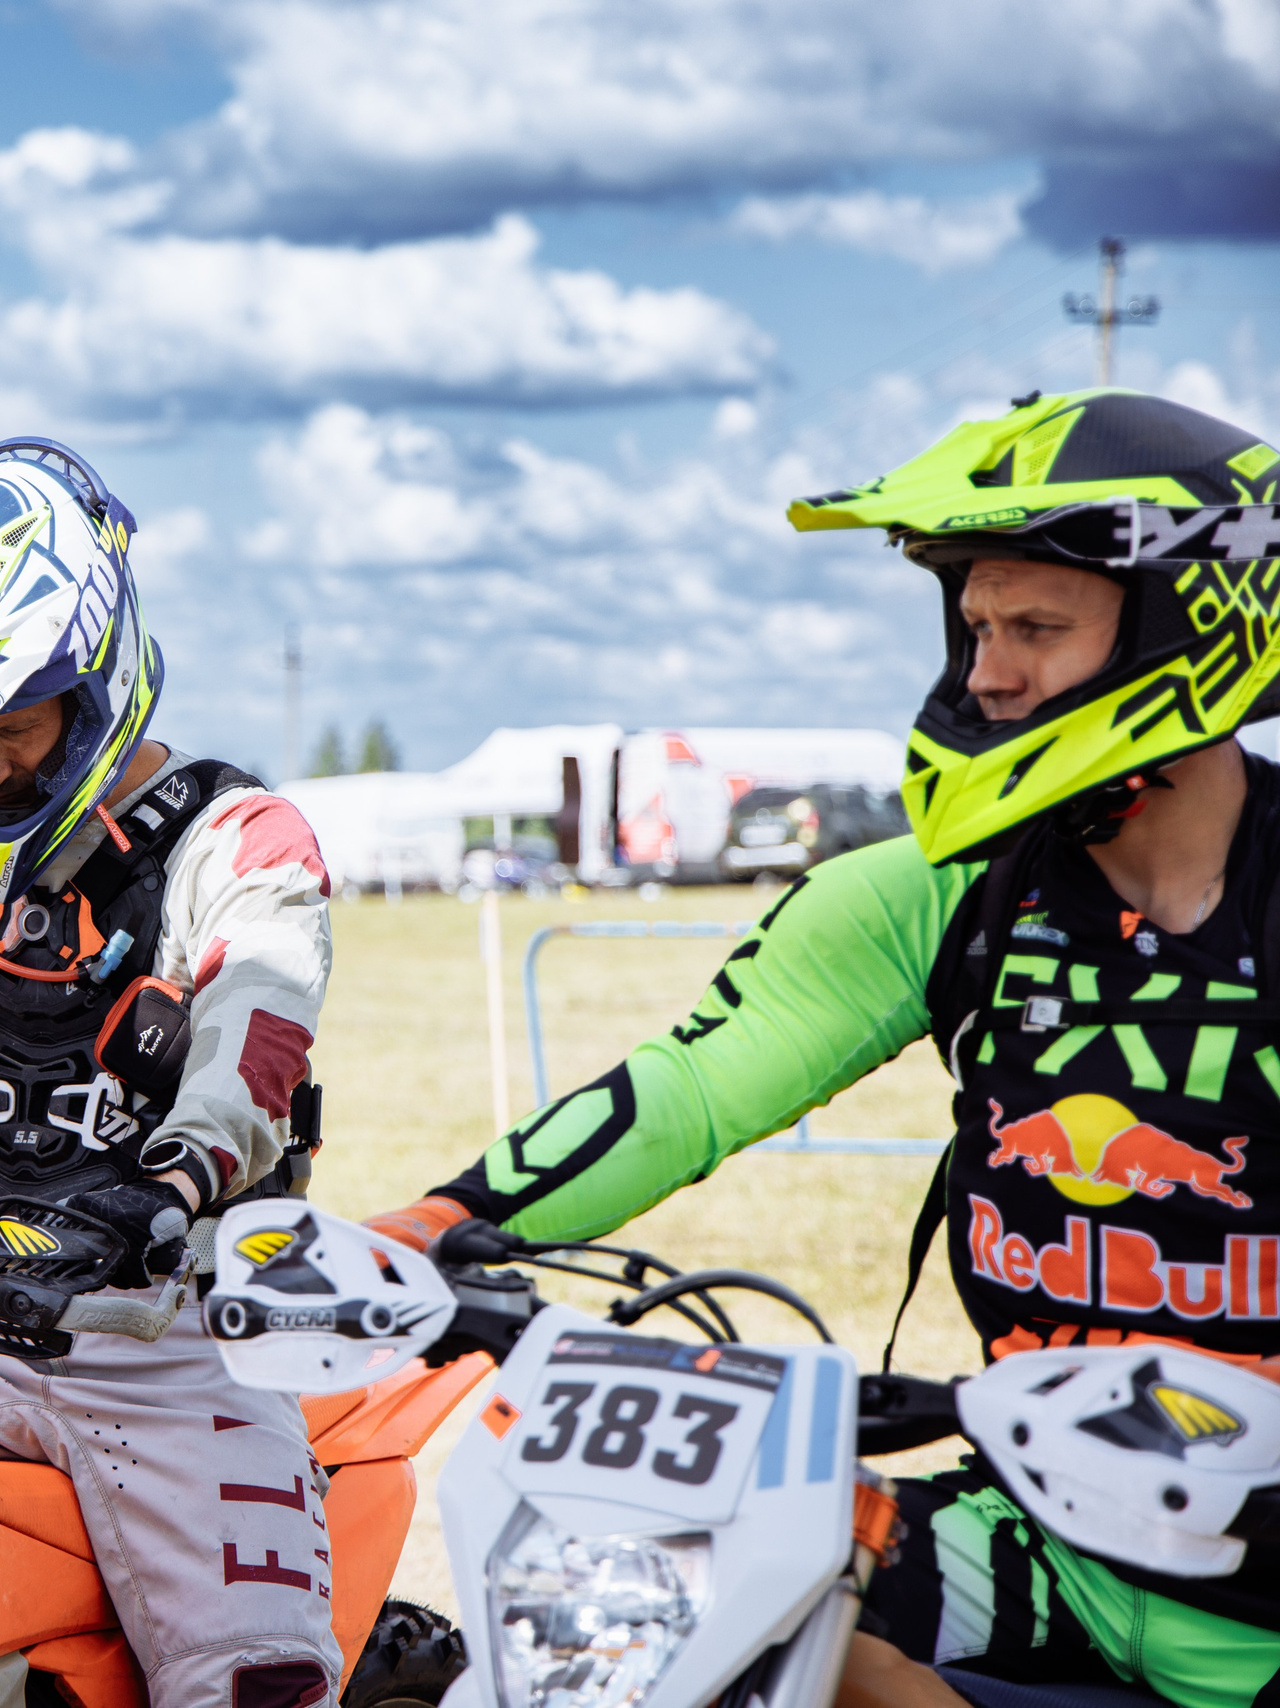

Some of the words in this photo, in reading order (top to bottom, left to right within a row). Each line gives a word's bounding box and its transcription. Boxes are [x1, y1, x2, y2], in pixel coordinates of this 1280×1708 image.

[154, 789, 183, 811] USWE
[0, 856, 14, 888] Airoh
[14, 1131, 37, 1144] 5.5
[968, 1193, 1092, 1307] Red
[1100, 1223, 1280, 1321] Bull
[265, 1308, 337, 1331] CYCRA
[521, 1382, 741, 1486] 383
